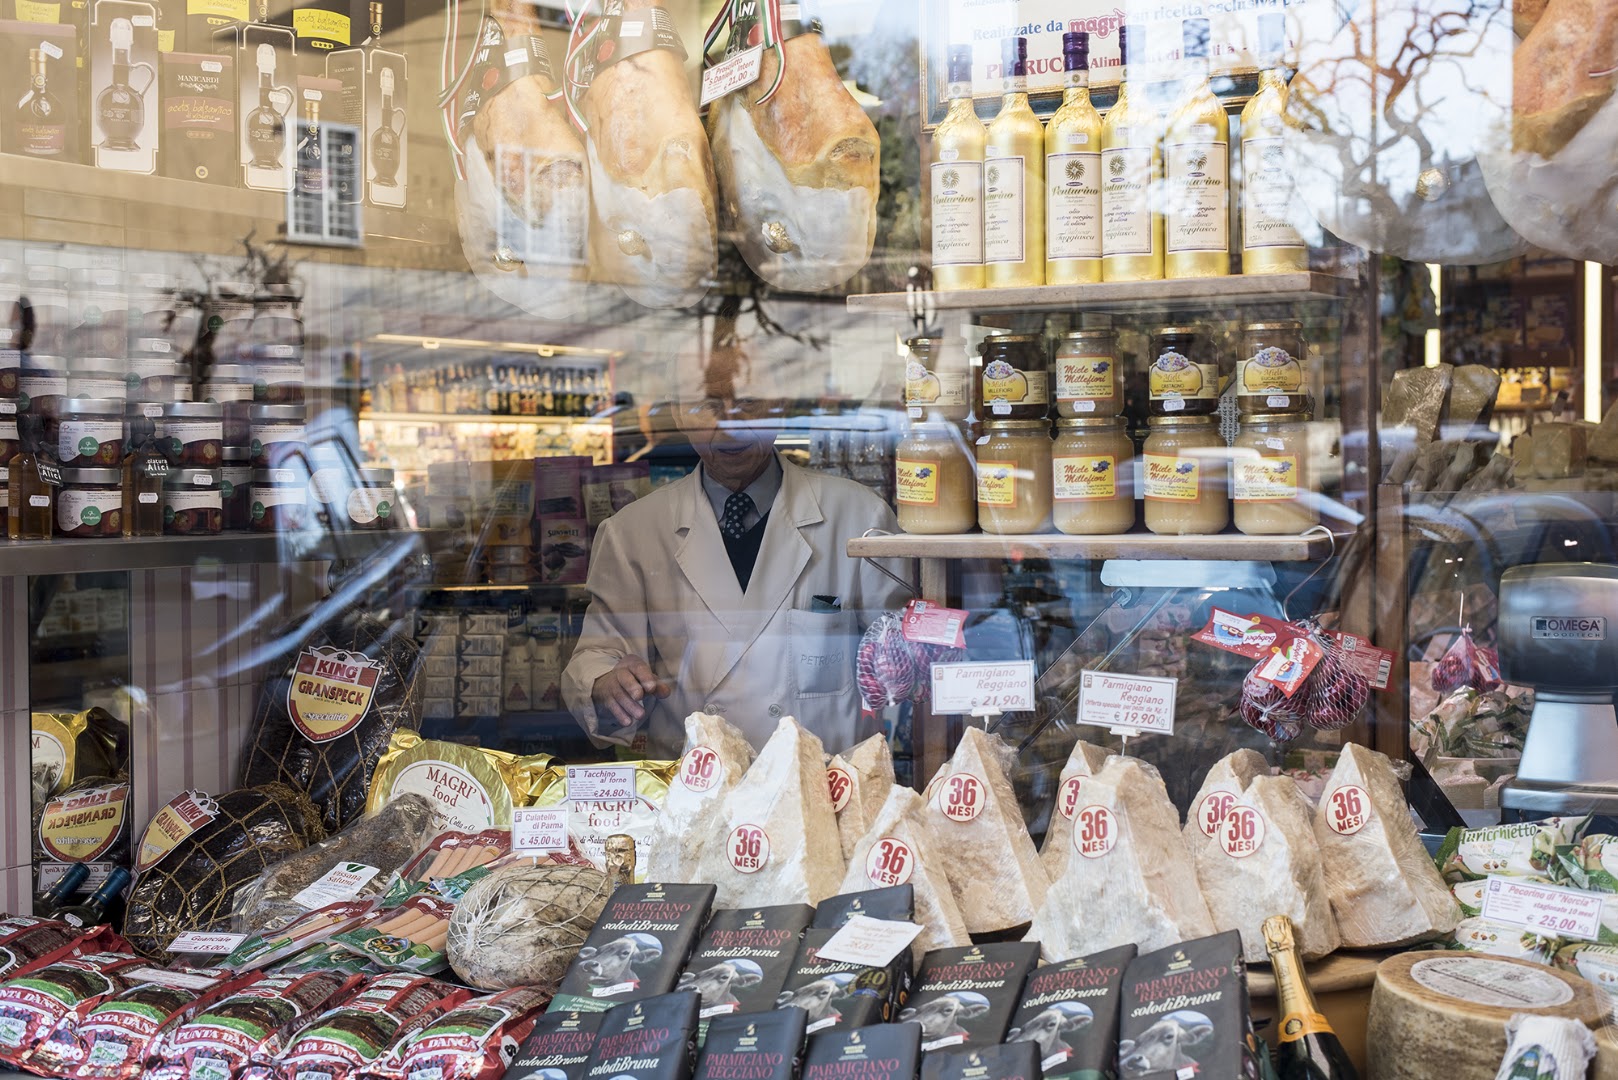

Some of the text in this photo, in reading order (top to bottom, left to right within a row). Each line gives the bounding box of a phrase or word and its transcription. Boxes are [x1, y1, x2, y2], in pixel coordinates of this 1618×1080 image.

[1046, 20, 1063, 33] da
[177, 74, 219, 84] MANICARDI
[192, 100, 232, 116] balsamico
[1064, 365, 1089, 374] Miele
[1064, 374, 1106, 385] Millefiori
[1064, 465, 1089, 474] Miele
[1150, 463, 1172, 473] Miele
[1064, 474, 1107, 486] Millefiori
[1150, 472, 1189, 485] Millefiori
[547, 528, 579, 537] SUNSWEET
[1548, 619, 1600, 631] OMEGA
[956, 668, 1016, 679] Parmigiano
[976, 679, 1027, 691] Reggiano
[1102, 679, 1152, 693] Parmigiano
[298, 680, 364, 706] GRANSPECK
[1120, 692, 1164, 705] Reggiano
[971, 695, 1018, 707] € 21,90
[1102, 701, 1121, 709] speciale
[1113, 711, 1120, 721] €
[1123, 711, 1155, 724] 19,90
[689, 749, 713, 777] 36
[583, 770, 616, 778] Tacchino
[685, 774, 710, 789] MESI
[432, 785, 459, 807] food
[600, 789, 624, 797] 24.80
[949, 777, 976, 807] 36
[1067, 780, 1080, 805] 3
[1207, 796, 1233, 823] 36
[1334, 788, 1361, 820] 36
[525, 813, 556, 821] Culatello
[947, 806, 975, 818] MESI
[588, 813, 620, 827] food
[1081, 810, 1108, 839] 36
[1228, 810, 1255, 840] 36
[1337, 815, 1364, 832] MESI
[1206, 823, 1221, 835] ME
[520, 838, 525, 846] €
[529, 836, 551, 845] 45,00
[736, 827, 762, 857] 36
[1082, 839, 1109, 853] MESI
[1228, 840, 1255, 853] MESI
[735, 857, 759, 869] MESI
[876, 841, 906, 874] 36
[871, 868, 900, 885] MESI
[1508, 885, 1545, 899] Pecorino
[1546, 892, 1556, 900] di
[612, 902, 691, 911] PARMIGIANO
[1533, 903, 1594, 918] stagionato 10 mesi
[613, 911, 681, 920] REGGIANO
[1526, 914, 1535, 922] €
[1539, 914, 1577, 930] 25,00
[602, 920, 679, 931] solodiBruna
[711, 929, 791, 939] PARMIGIANO
[712, 938, 780, 946] REGGIANO
[701, 946, 780, 957] solodiBruna
[927, 961, 1015, 975] PARMIGIANO
[861, 971, 886, 985] 40
[930, 970, 1005, 981] REGGIANO
[1134, 966, 1228, 994] PARMIGIANO
[920, 980, 1005, 991] solodiBruna
[1032, 976, 1108, 994] REGGIANO
[1139, 979, 1219, 1003] REGGIANO
[1023, 987, 1109, 1009] solodiBruna
[1130, 990, 1222, 1018] solodiBruna
[176, 1029, 219, 1040] PUNTA
[598, 1027, 670, 1049] PARMIGIANO
[529, 1042, 592, 1055] REGGIANO
[599, 1041, 661, 1059] REGGIANO
[515, 1055, 588, 1067] solodiBruna
[705, 1052, 783, 1066] PARMIGIANO
[589, 1056, 659, 1077] solodiBruna
[707, 1066, 773, 1079] REGGIANO
[808, 1058, 900, 1077] PARMIGIANO
